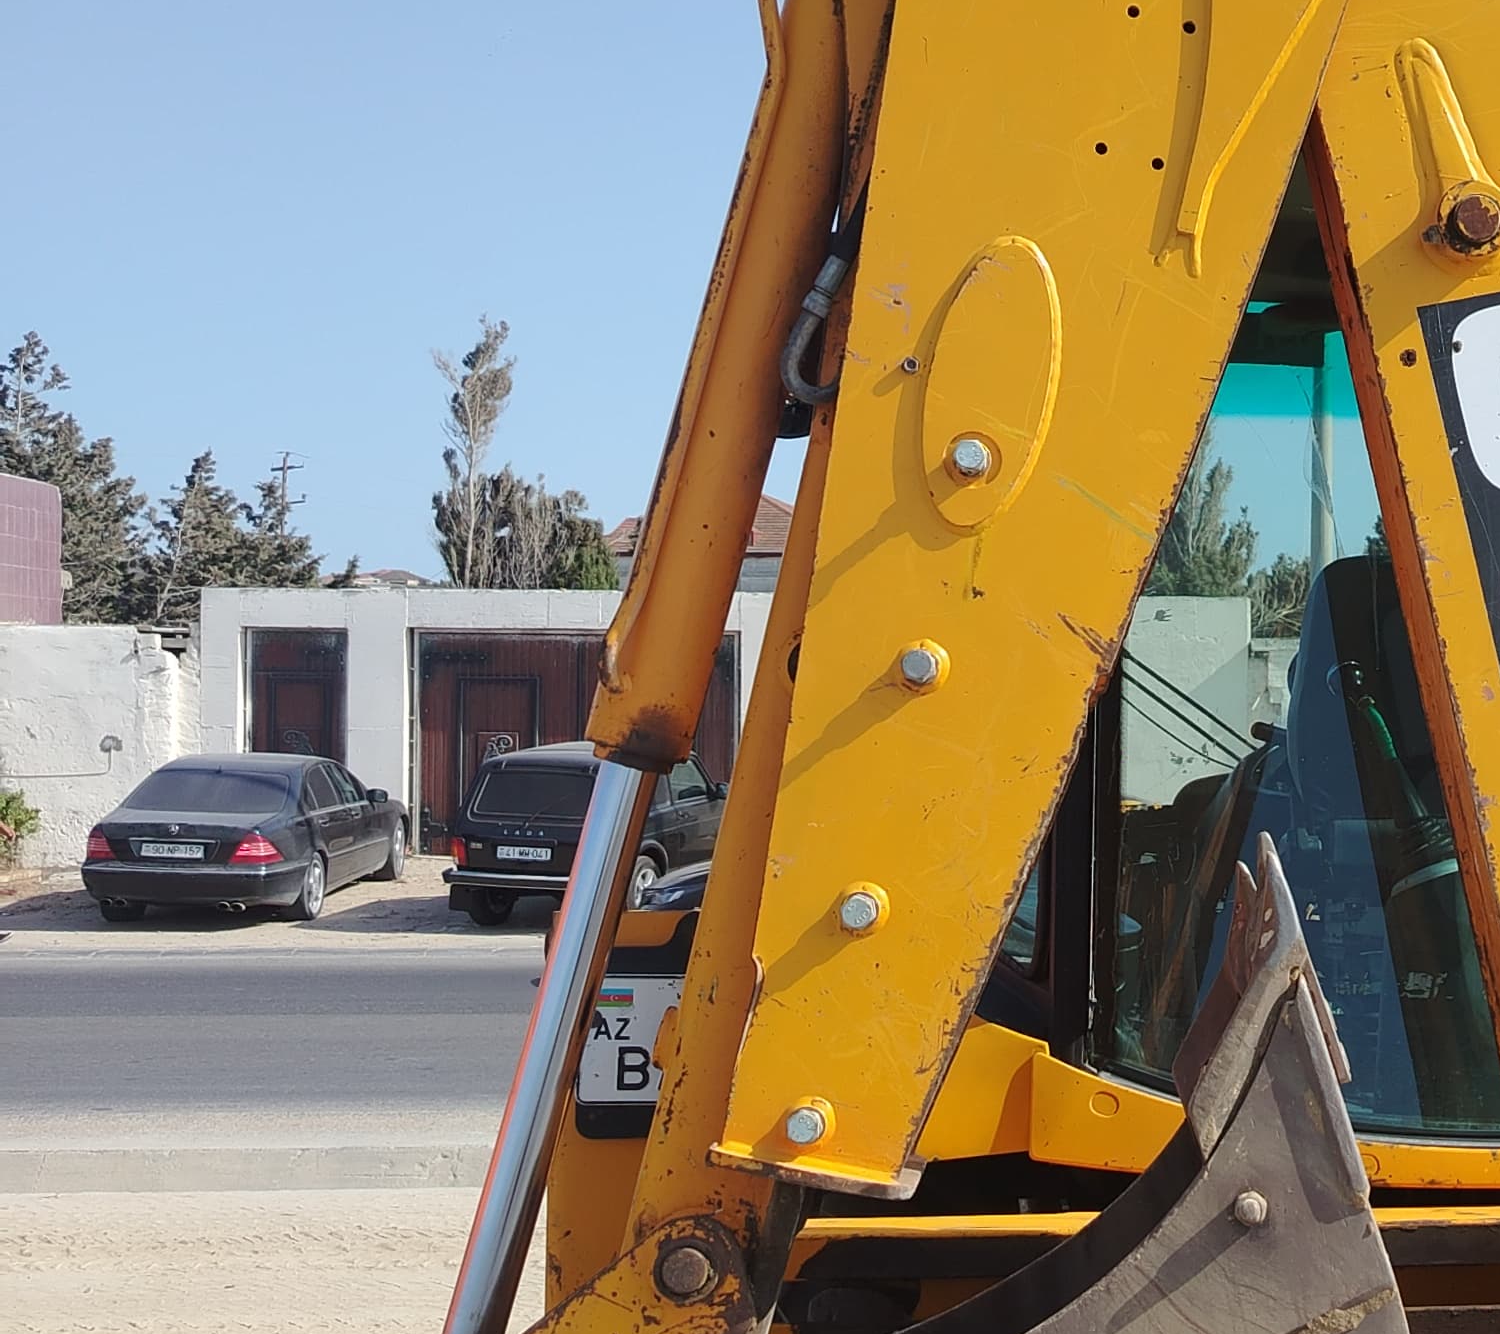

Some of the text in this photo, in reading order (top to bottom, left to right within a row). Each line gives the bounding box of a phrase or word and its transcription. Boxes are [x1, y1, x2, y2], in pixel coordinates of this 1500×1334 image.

[503, 828, 544, 836] LADA
[593, 1017, 630, 1040] AZ
[616, 1046, 664, 1091] B
